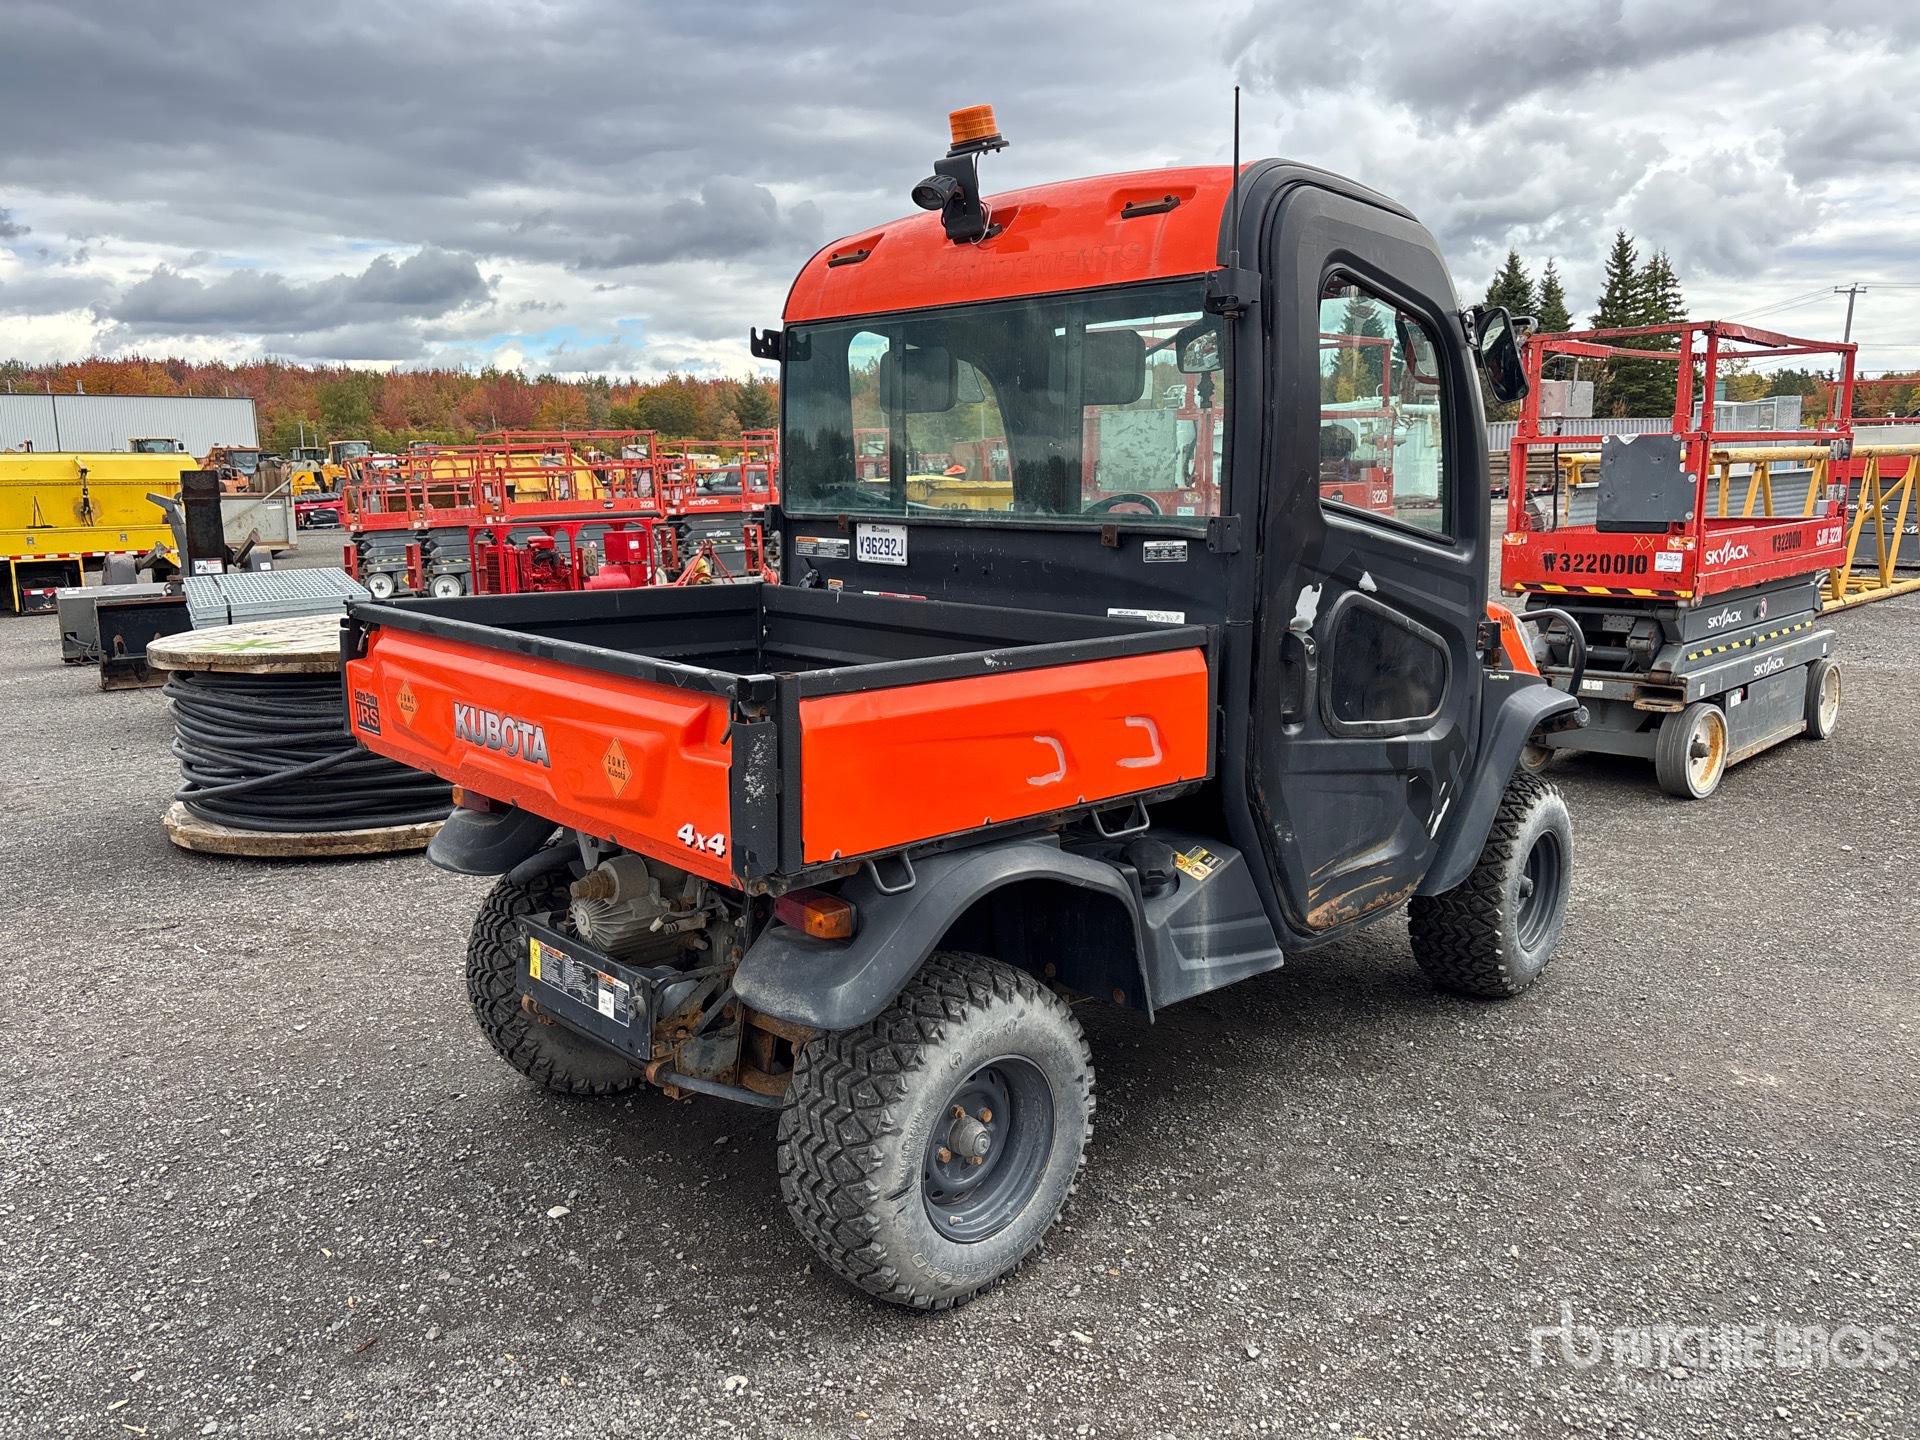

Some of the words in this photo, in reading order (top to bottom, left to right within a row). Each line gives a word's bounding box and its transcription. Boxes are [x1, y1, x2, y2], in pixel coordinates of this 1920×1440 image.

[688, 497, 720, 507] SKYJACK
[1371, 489, 1388, 504] 3226
[1828, 526, 1843, 543] 3220
[859, 536, 904, 557] V36292J
[1705, 539, 1749, 566] SKYJACK
[1542, 553, 1648, 575] W3220010
[1707, 607, 1742, 629] SKYJACK
[1753, 655, 1785, 677] SKYJACK
[354, 689, 366, 701] Extra
[400, 692, 415, 704] ZONE
[357, 703, 379, 728] IRS
[400, 703, 415, 713] Kubota
[453, 703, 551, 768] KUBOTA
[607, 754, 627, 770] ZONE
[607, 766, 627, 781] Kubota
[676, 823, 726, 857] 4x4
